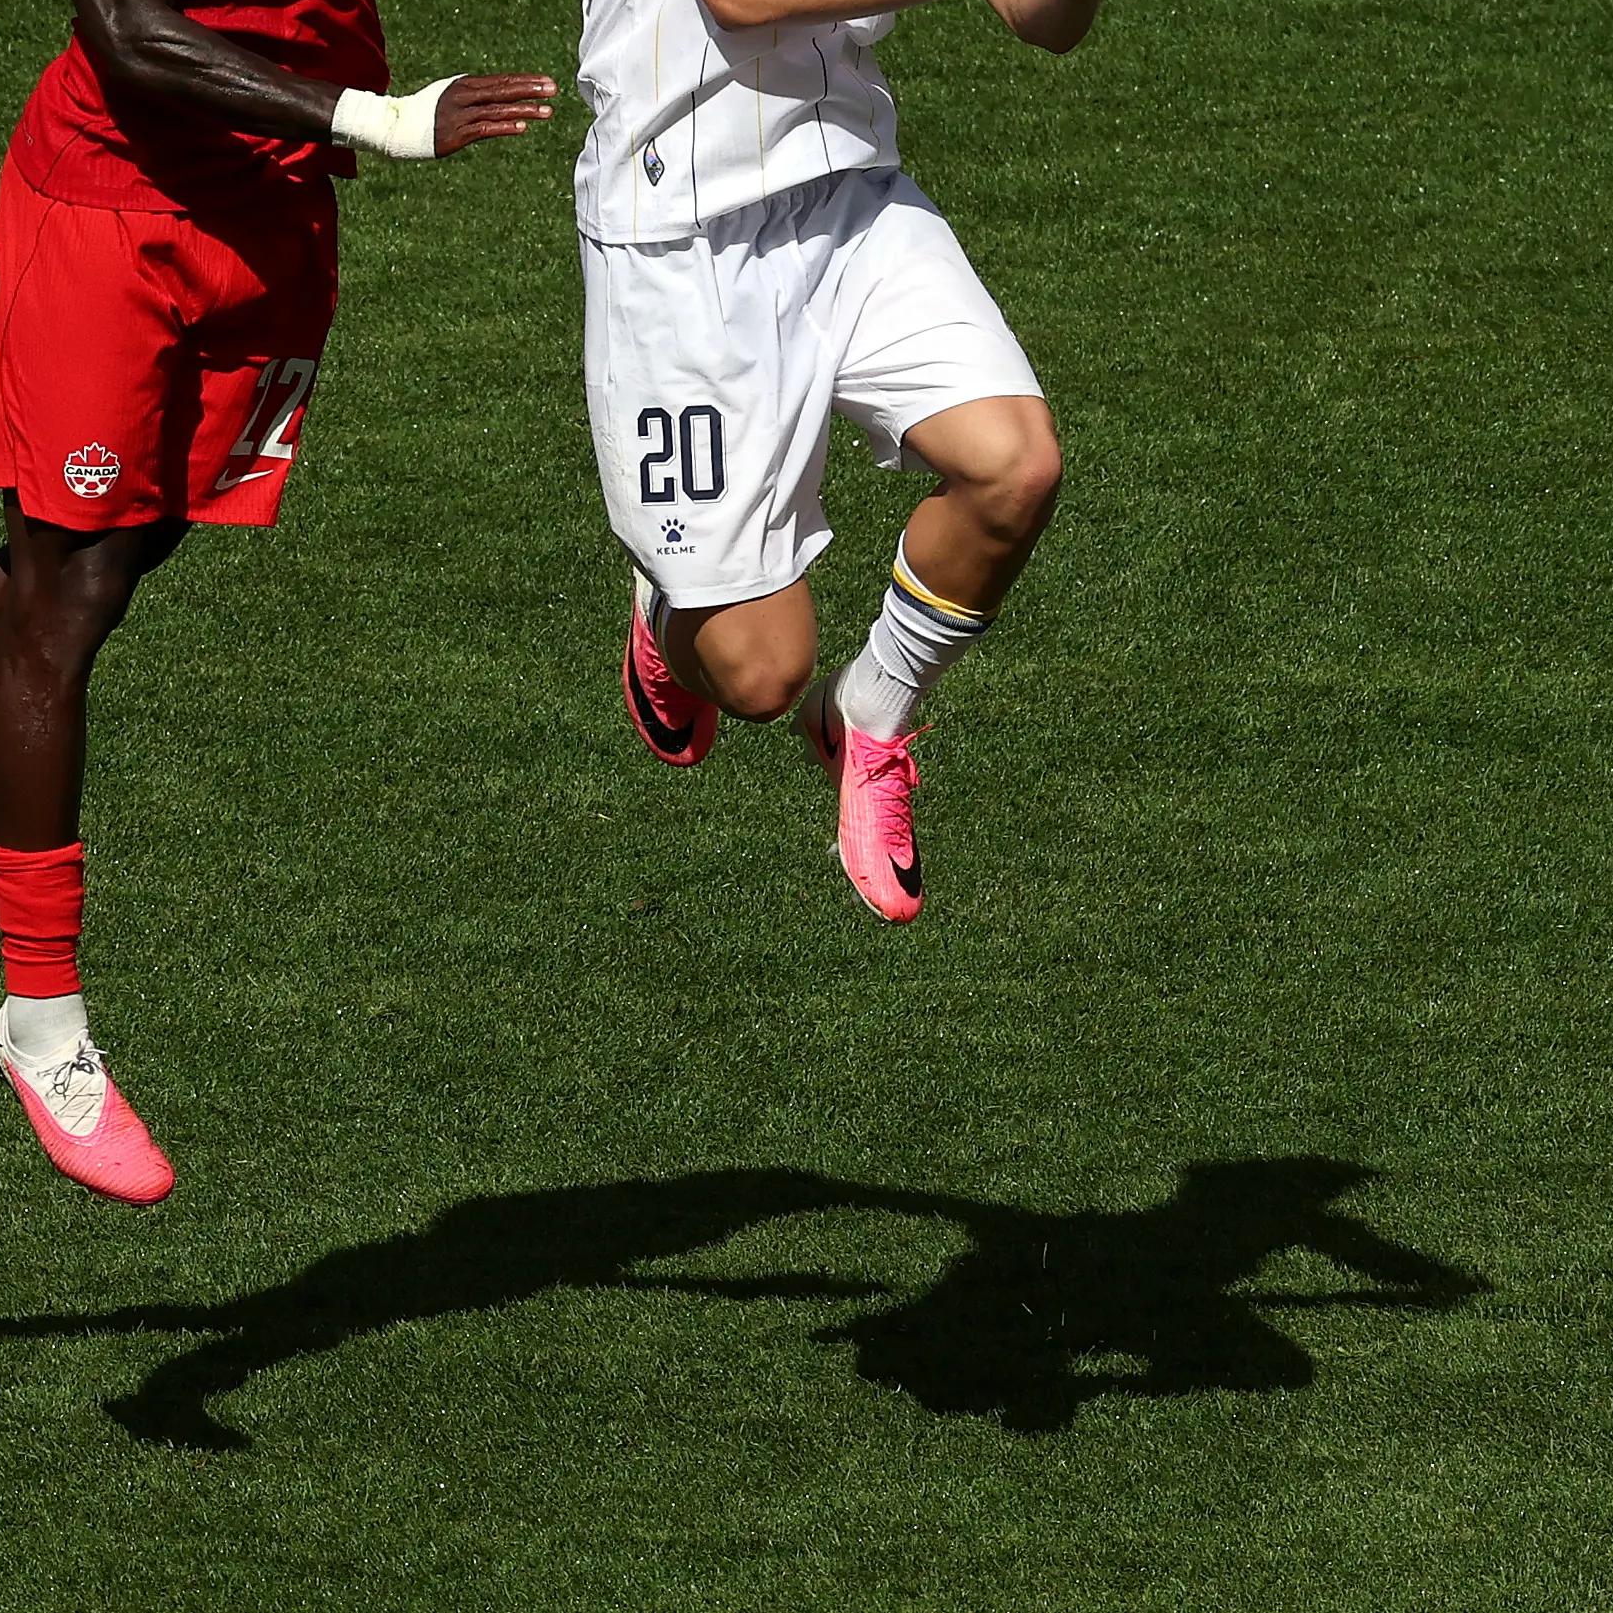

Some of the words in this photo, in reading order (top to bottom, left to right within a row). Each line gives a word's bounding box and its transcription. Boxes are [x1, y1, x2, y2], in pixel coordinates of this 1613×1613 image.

[637, 404, 728, 506] 20
[66, 466, 117, 477] CANADA
[656, 545, 696, 556] KELME
